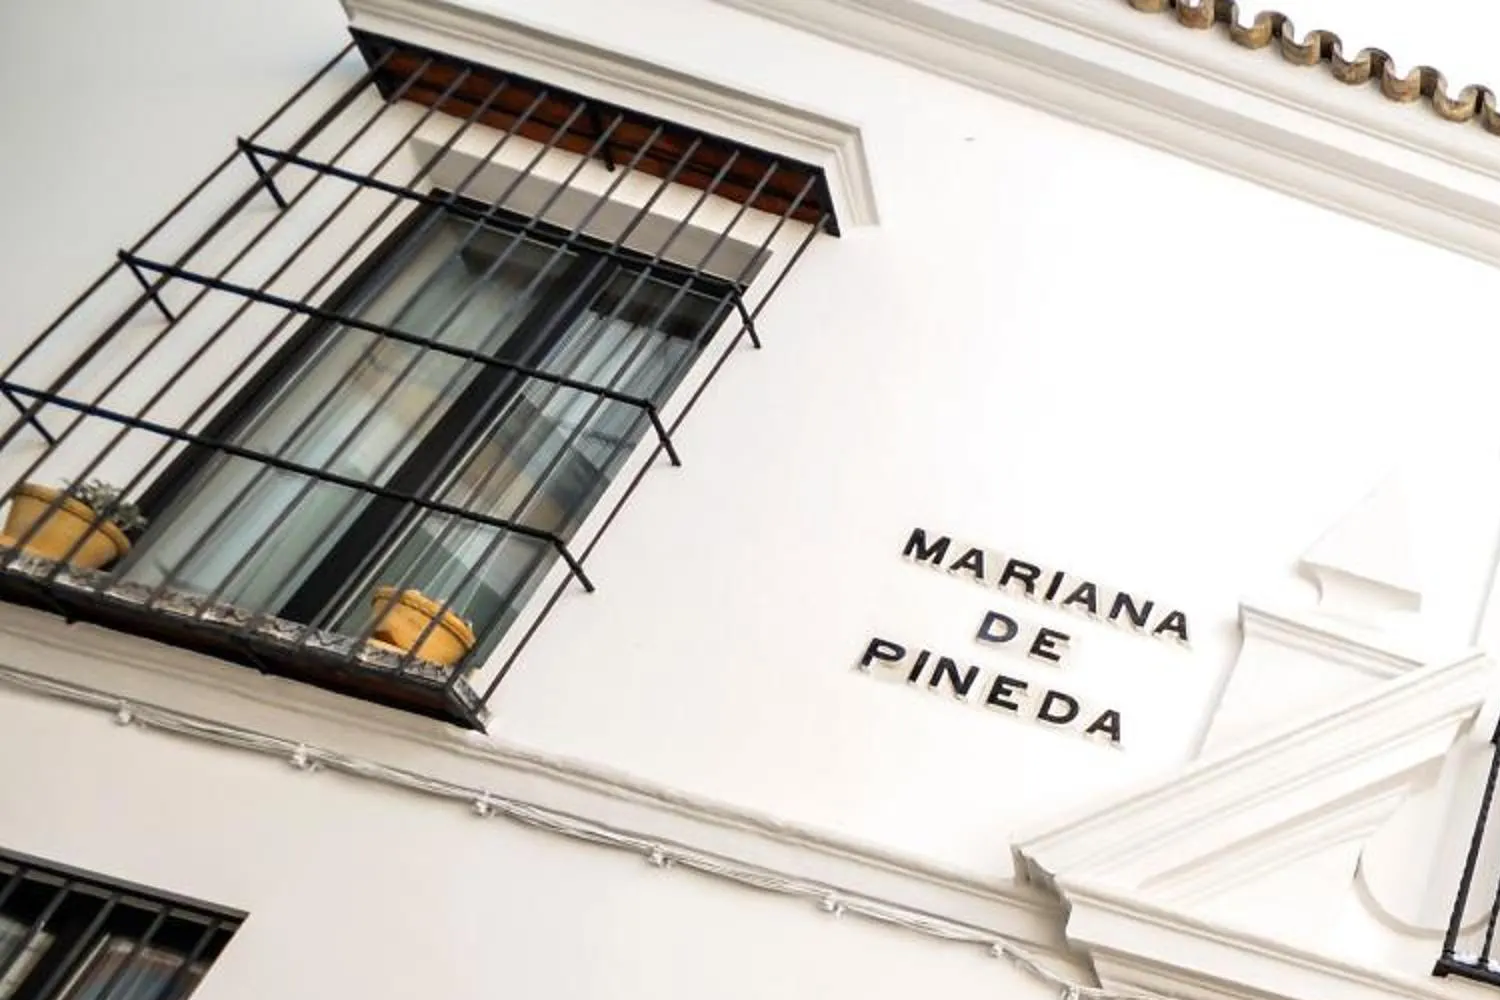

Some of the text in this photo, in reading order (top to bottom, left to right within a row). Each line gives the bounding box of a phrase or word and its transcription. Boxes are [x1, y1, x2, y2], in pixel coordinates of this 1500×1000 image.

[902, 527, 1190, 642] MARIANA
[975, 610, 1071, 662] DE
[859, 637, 1123, 743] PINEDA
